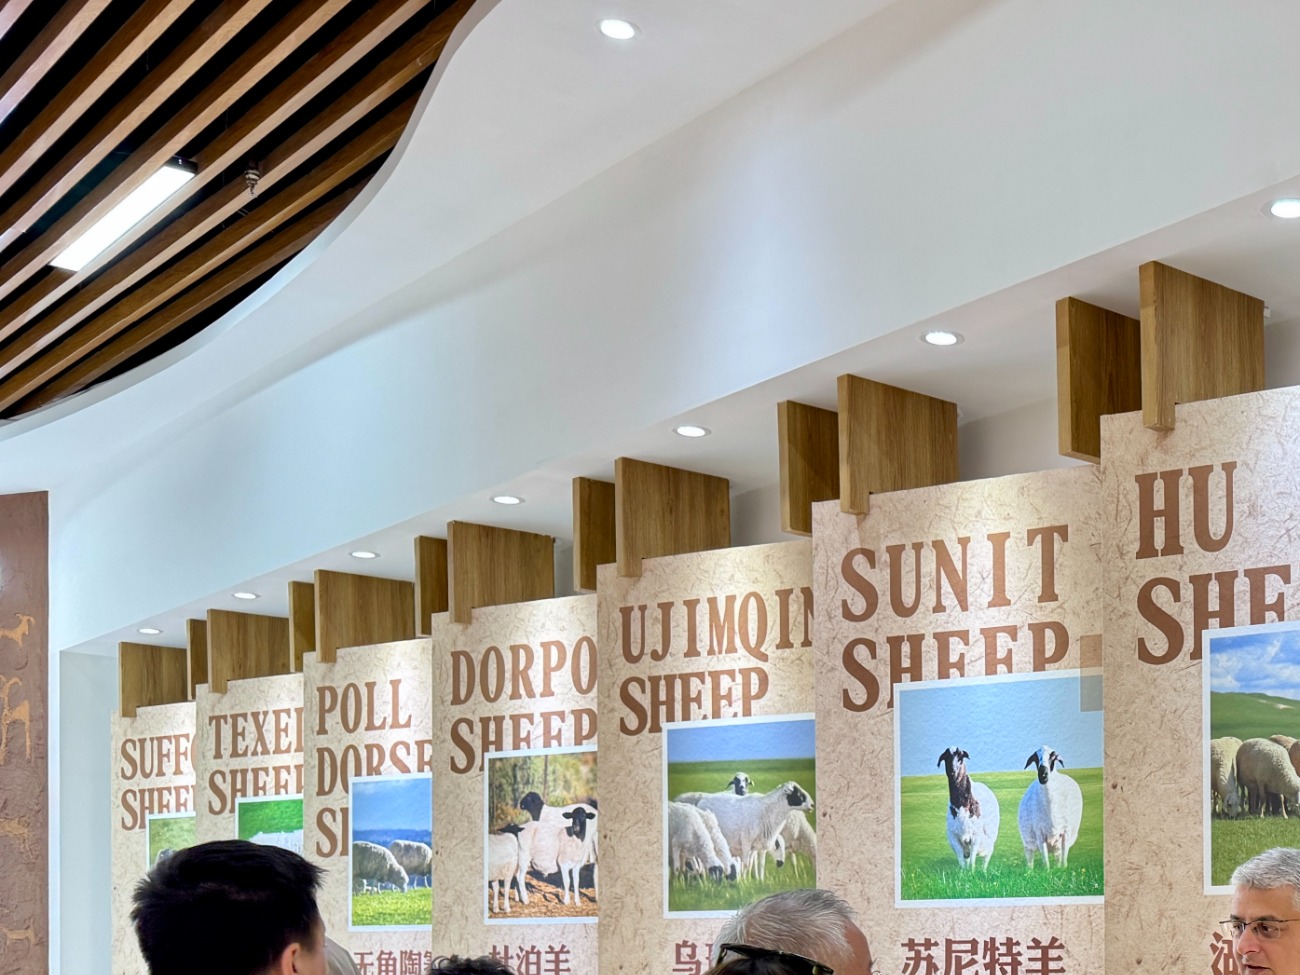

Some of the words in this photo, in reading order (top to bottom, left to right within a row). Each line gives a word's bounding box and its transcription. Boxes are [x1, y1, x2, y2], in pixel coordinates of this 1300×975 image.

[1135, 460, 1238, 560] HU
[840, 525, 1069, 623] SUNIT
[619, 667, 769, 737] SHEEP
[841, 621, 1070, 713] SHEEP
[316, 679, 412, 736] POLL
[450, 708, 598, 775] SHEEP
[120, 733, 197, 781] SUFF
